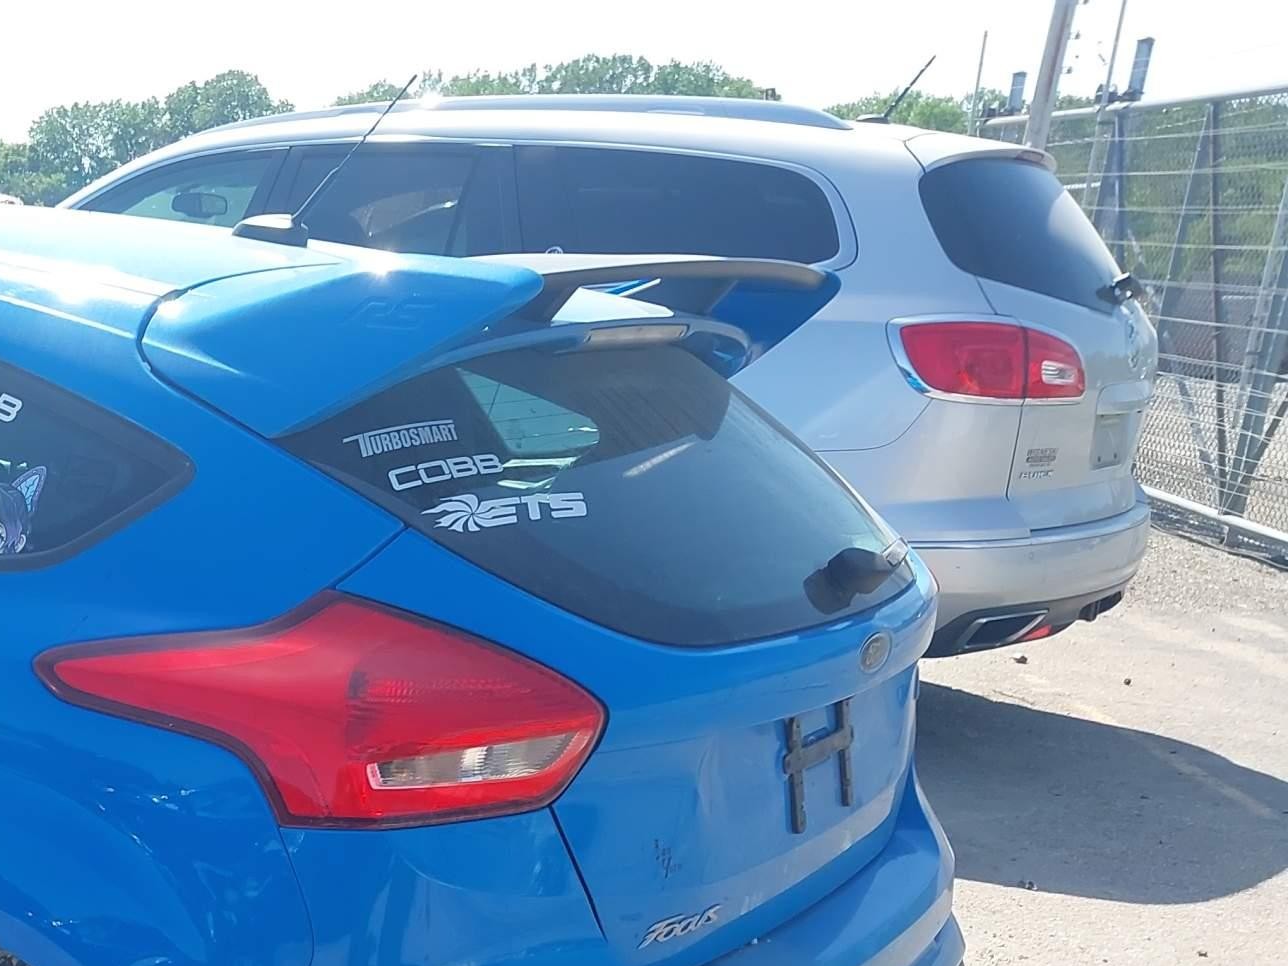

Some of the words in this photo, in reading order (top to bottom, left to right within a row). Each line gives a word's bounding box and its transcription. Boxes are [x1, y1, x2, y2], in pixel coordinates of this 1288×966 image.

[343, 418, 459, 458] TURBOSMART
[387, 453, 504, 491] COBB
[460, 492, 588, 532] ETS
